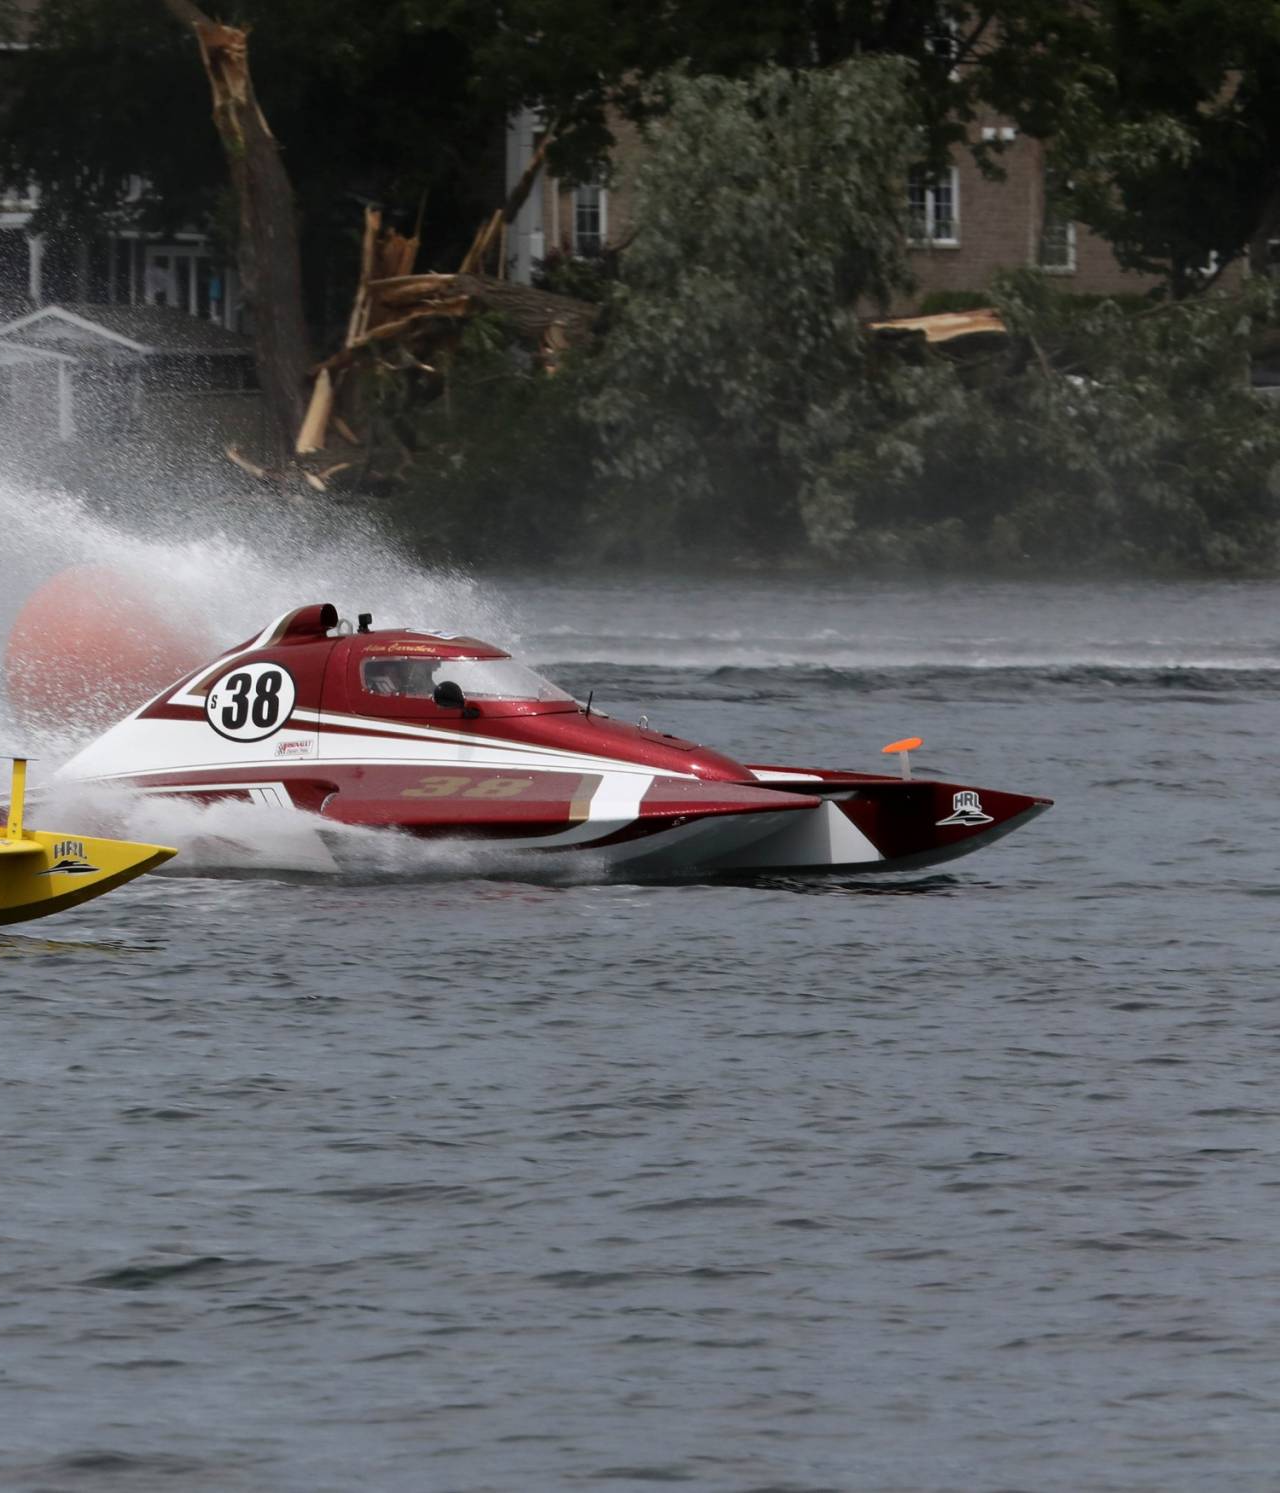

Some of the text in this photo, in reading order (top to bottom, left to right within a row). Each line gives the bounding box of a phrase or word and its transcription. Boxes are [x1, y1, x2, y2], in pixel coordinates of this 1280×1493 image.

[210, 670, 283, 730] S 38
[400, 776, 535, 798] 38
[954, 792, 981, 810] HRL
[54, 841, 87, 859] HRL
